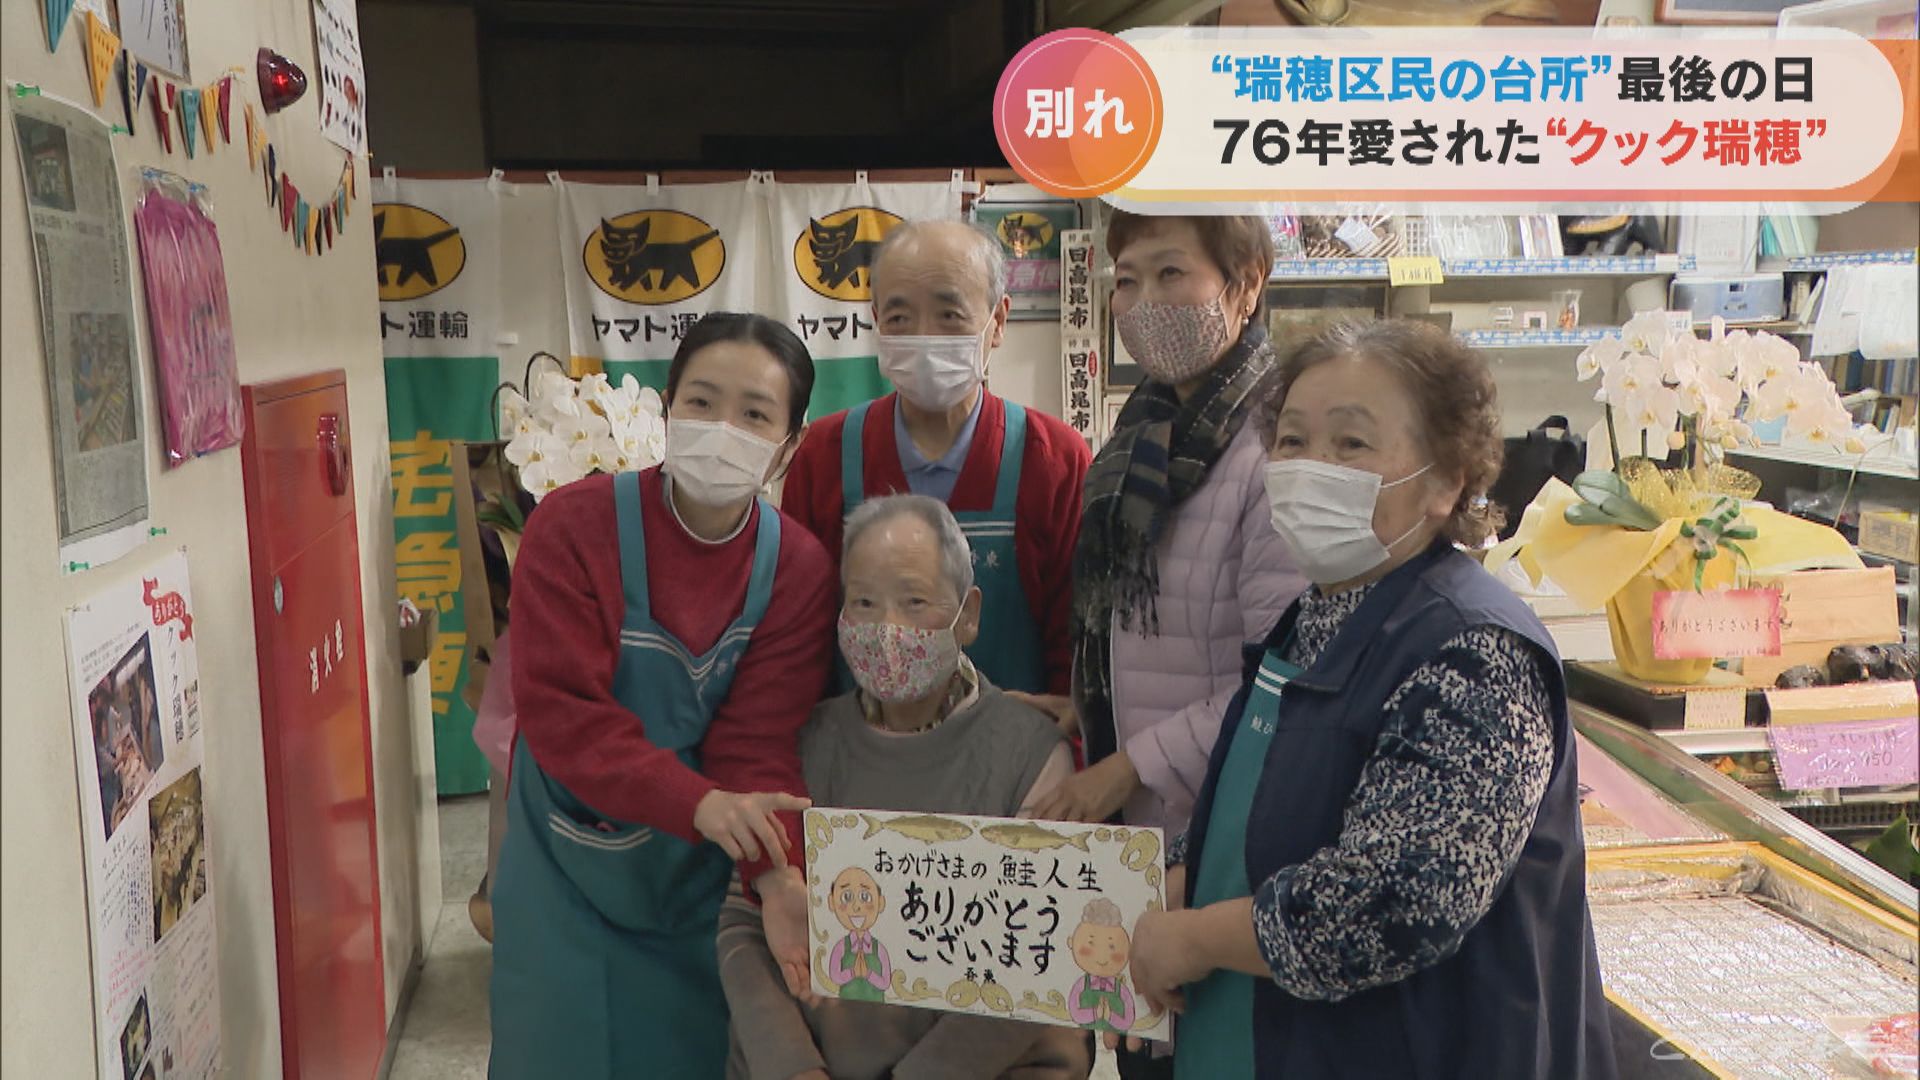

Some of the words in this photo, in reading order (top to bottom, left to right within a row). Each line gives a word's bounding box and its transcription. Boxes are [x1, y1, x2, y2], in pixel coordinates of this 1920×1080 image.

[591, 312, 709, 343] ヤマト運
[797, 312, 872, 341] ヤマト
[1659, 617, 1773, 633] ありがとうございます
[873, 846, 1103, 893] おかげさまの鮭人生
[900, 881, 1060, 937] ありがとう
[905, 924, 1056, 977] ございます
